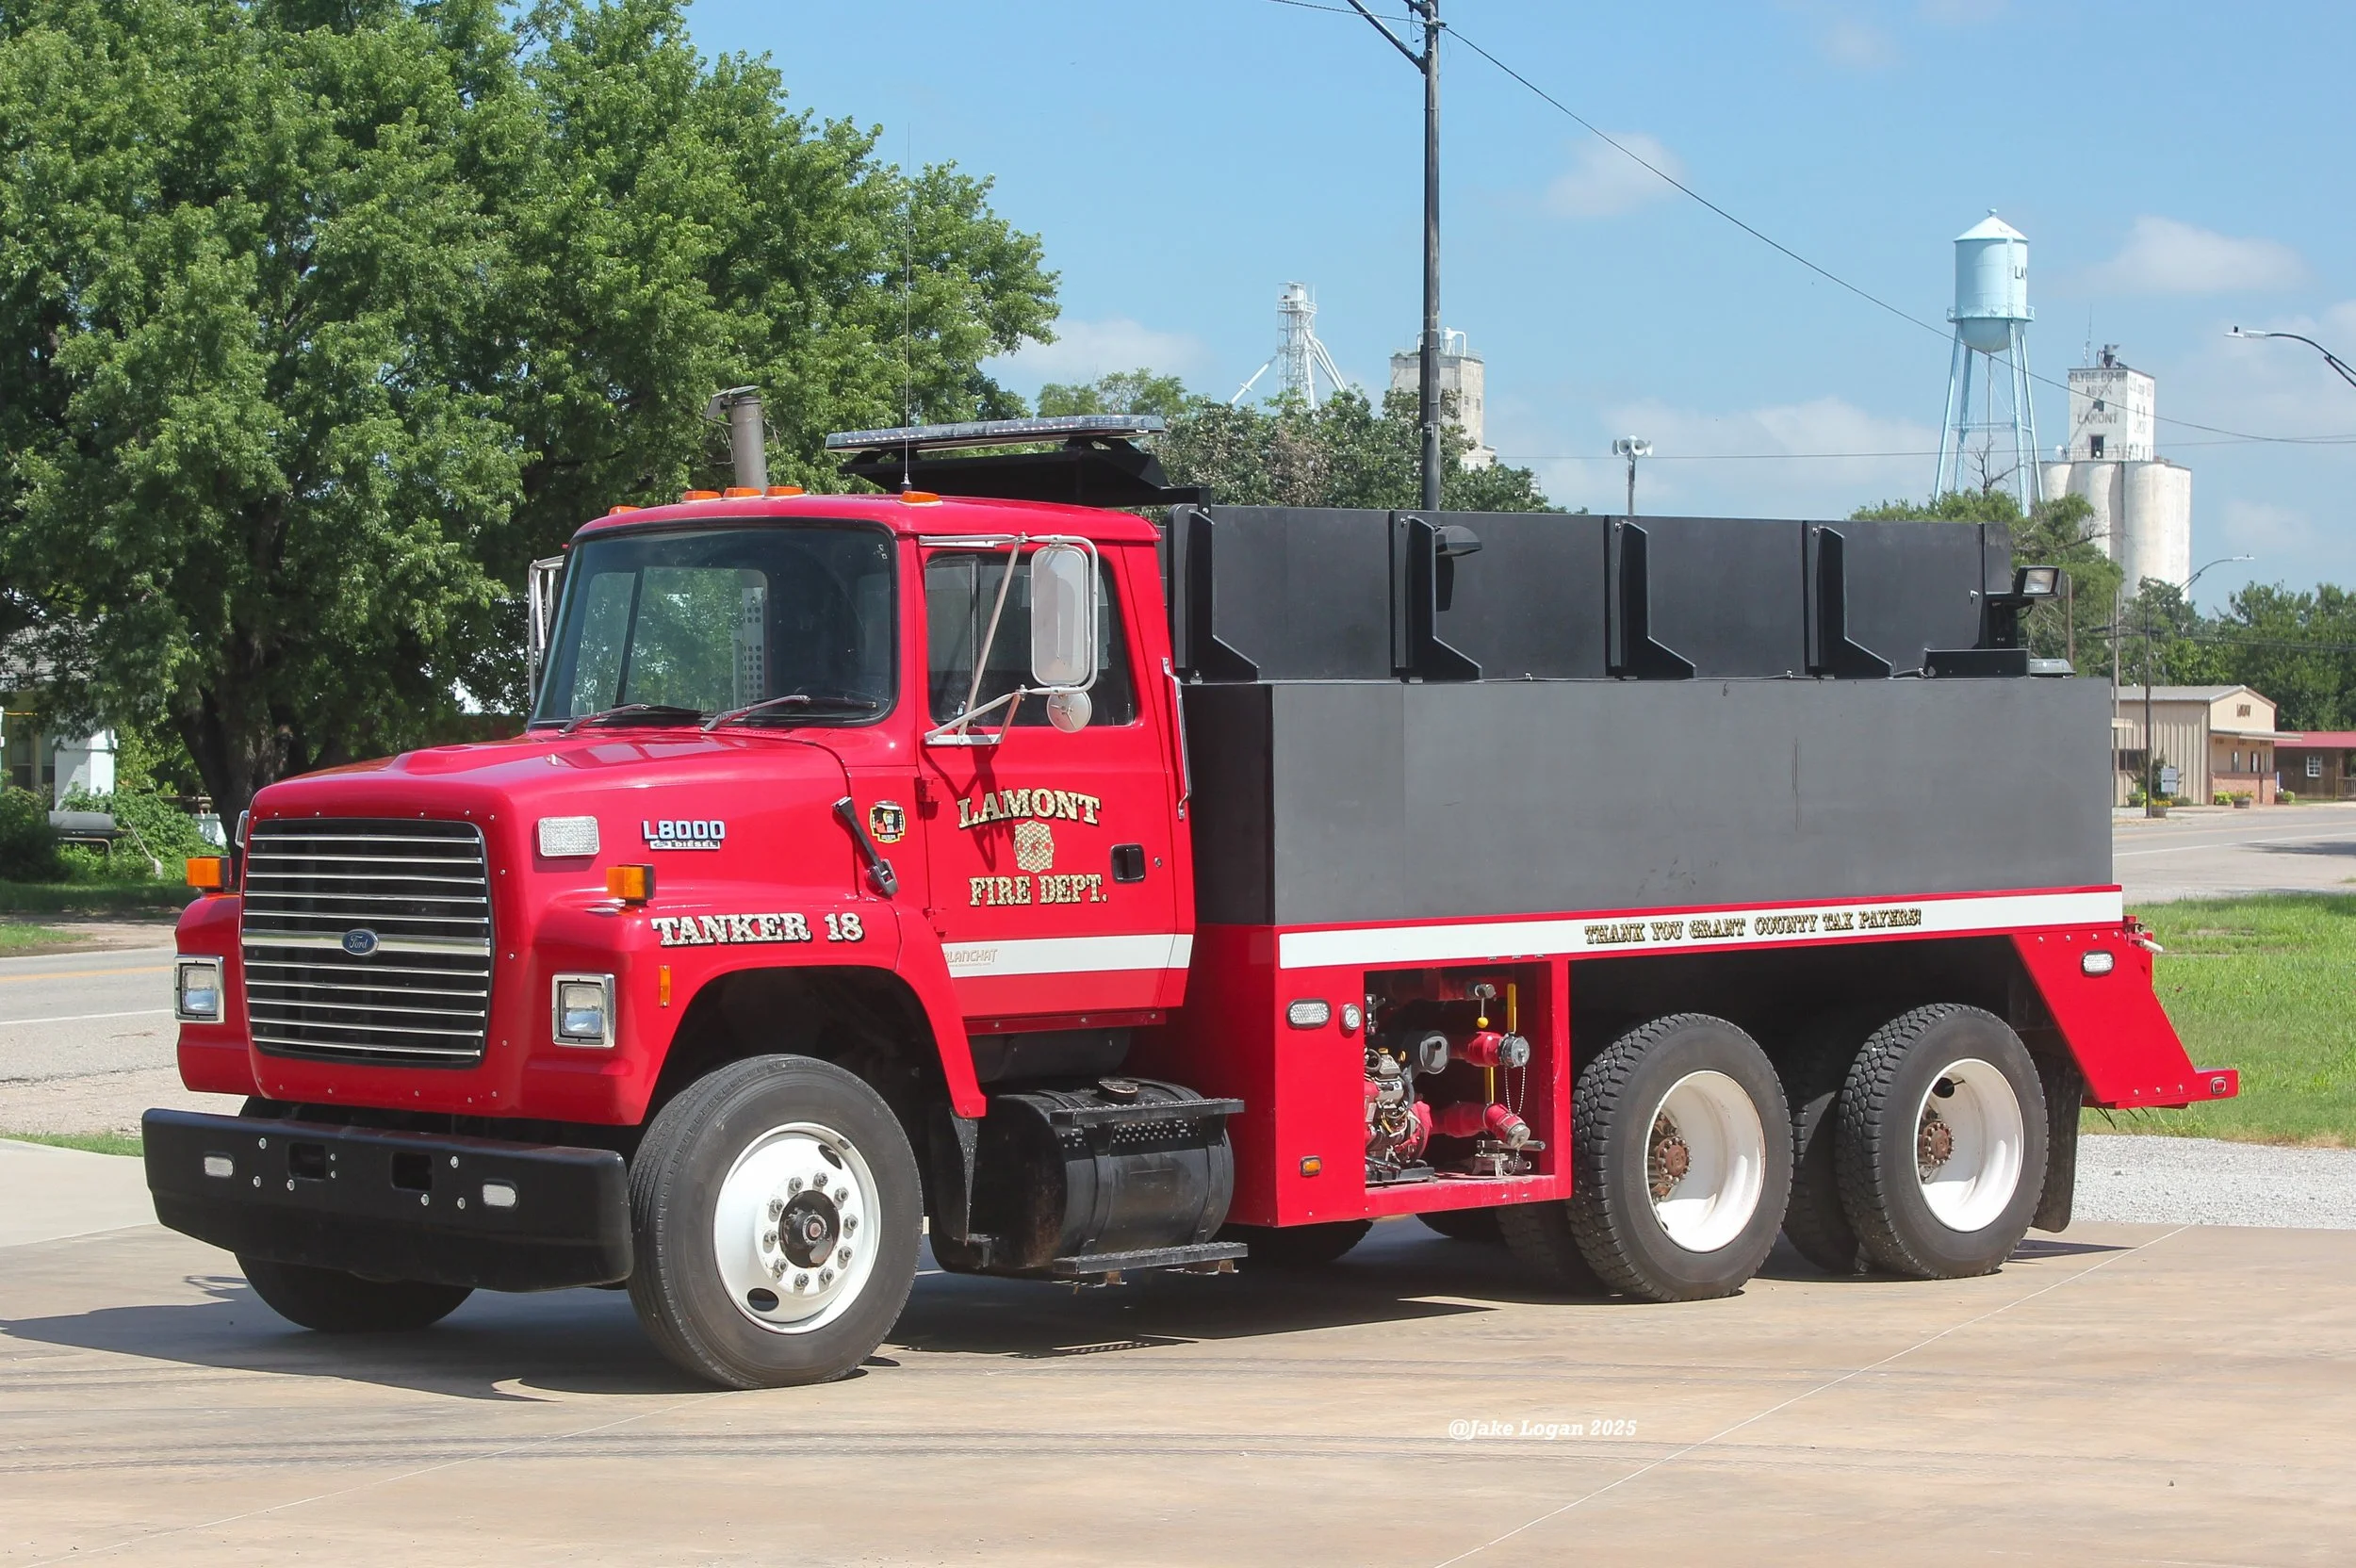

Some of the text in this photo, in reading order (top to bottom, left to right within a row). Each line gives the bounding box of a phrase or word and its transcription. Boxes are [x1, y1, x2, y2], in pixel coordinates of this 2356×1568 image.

[2077, 413, 2118, 424] LAMONT
[957, 788, 1101, 829] LAMONT
[642, 819, 726, 840] L8000
[969, 874, 1108, 906] FIRE DEPT.
[349, 934, 368, 949] Ford
[650, 912, 865, 946] TANKER 18
[1584, 907, 1922, 944] THANK YOU GRANT COUNTY TAX PAYERS!
